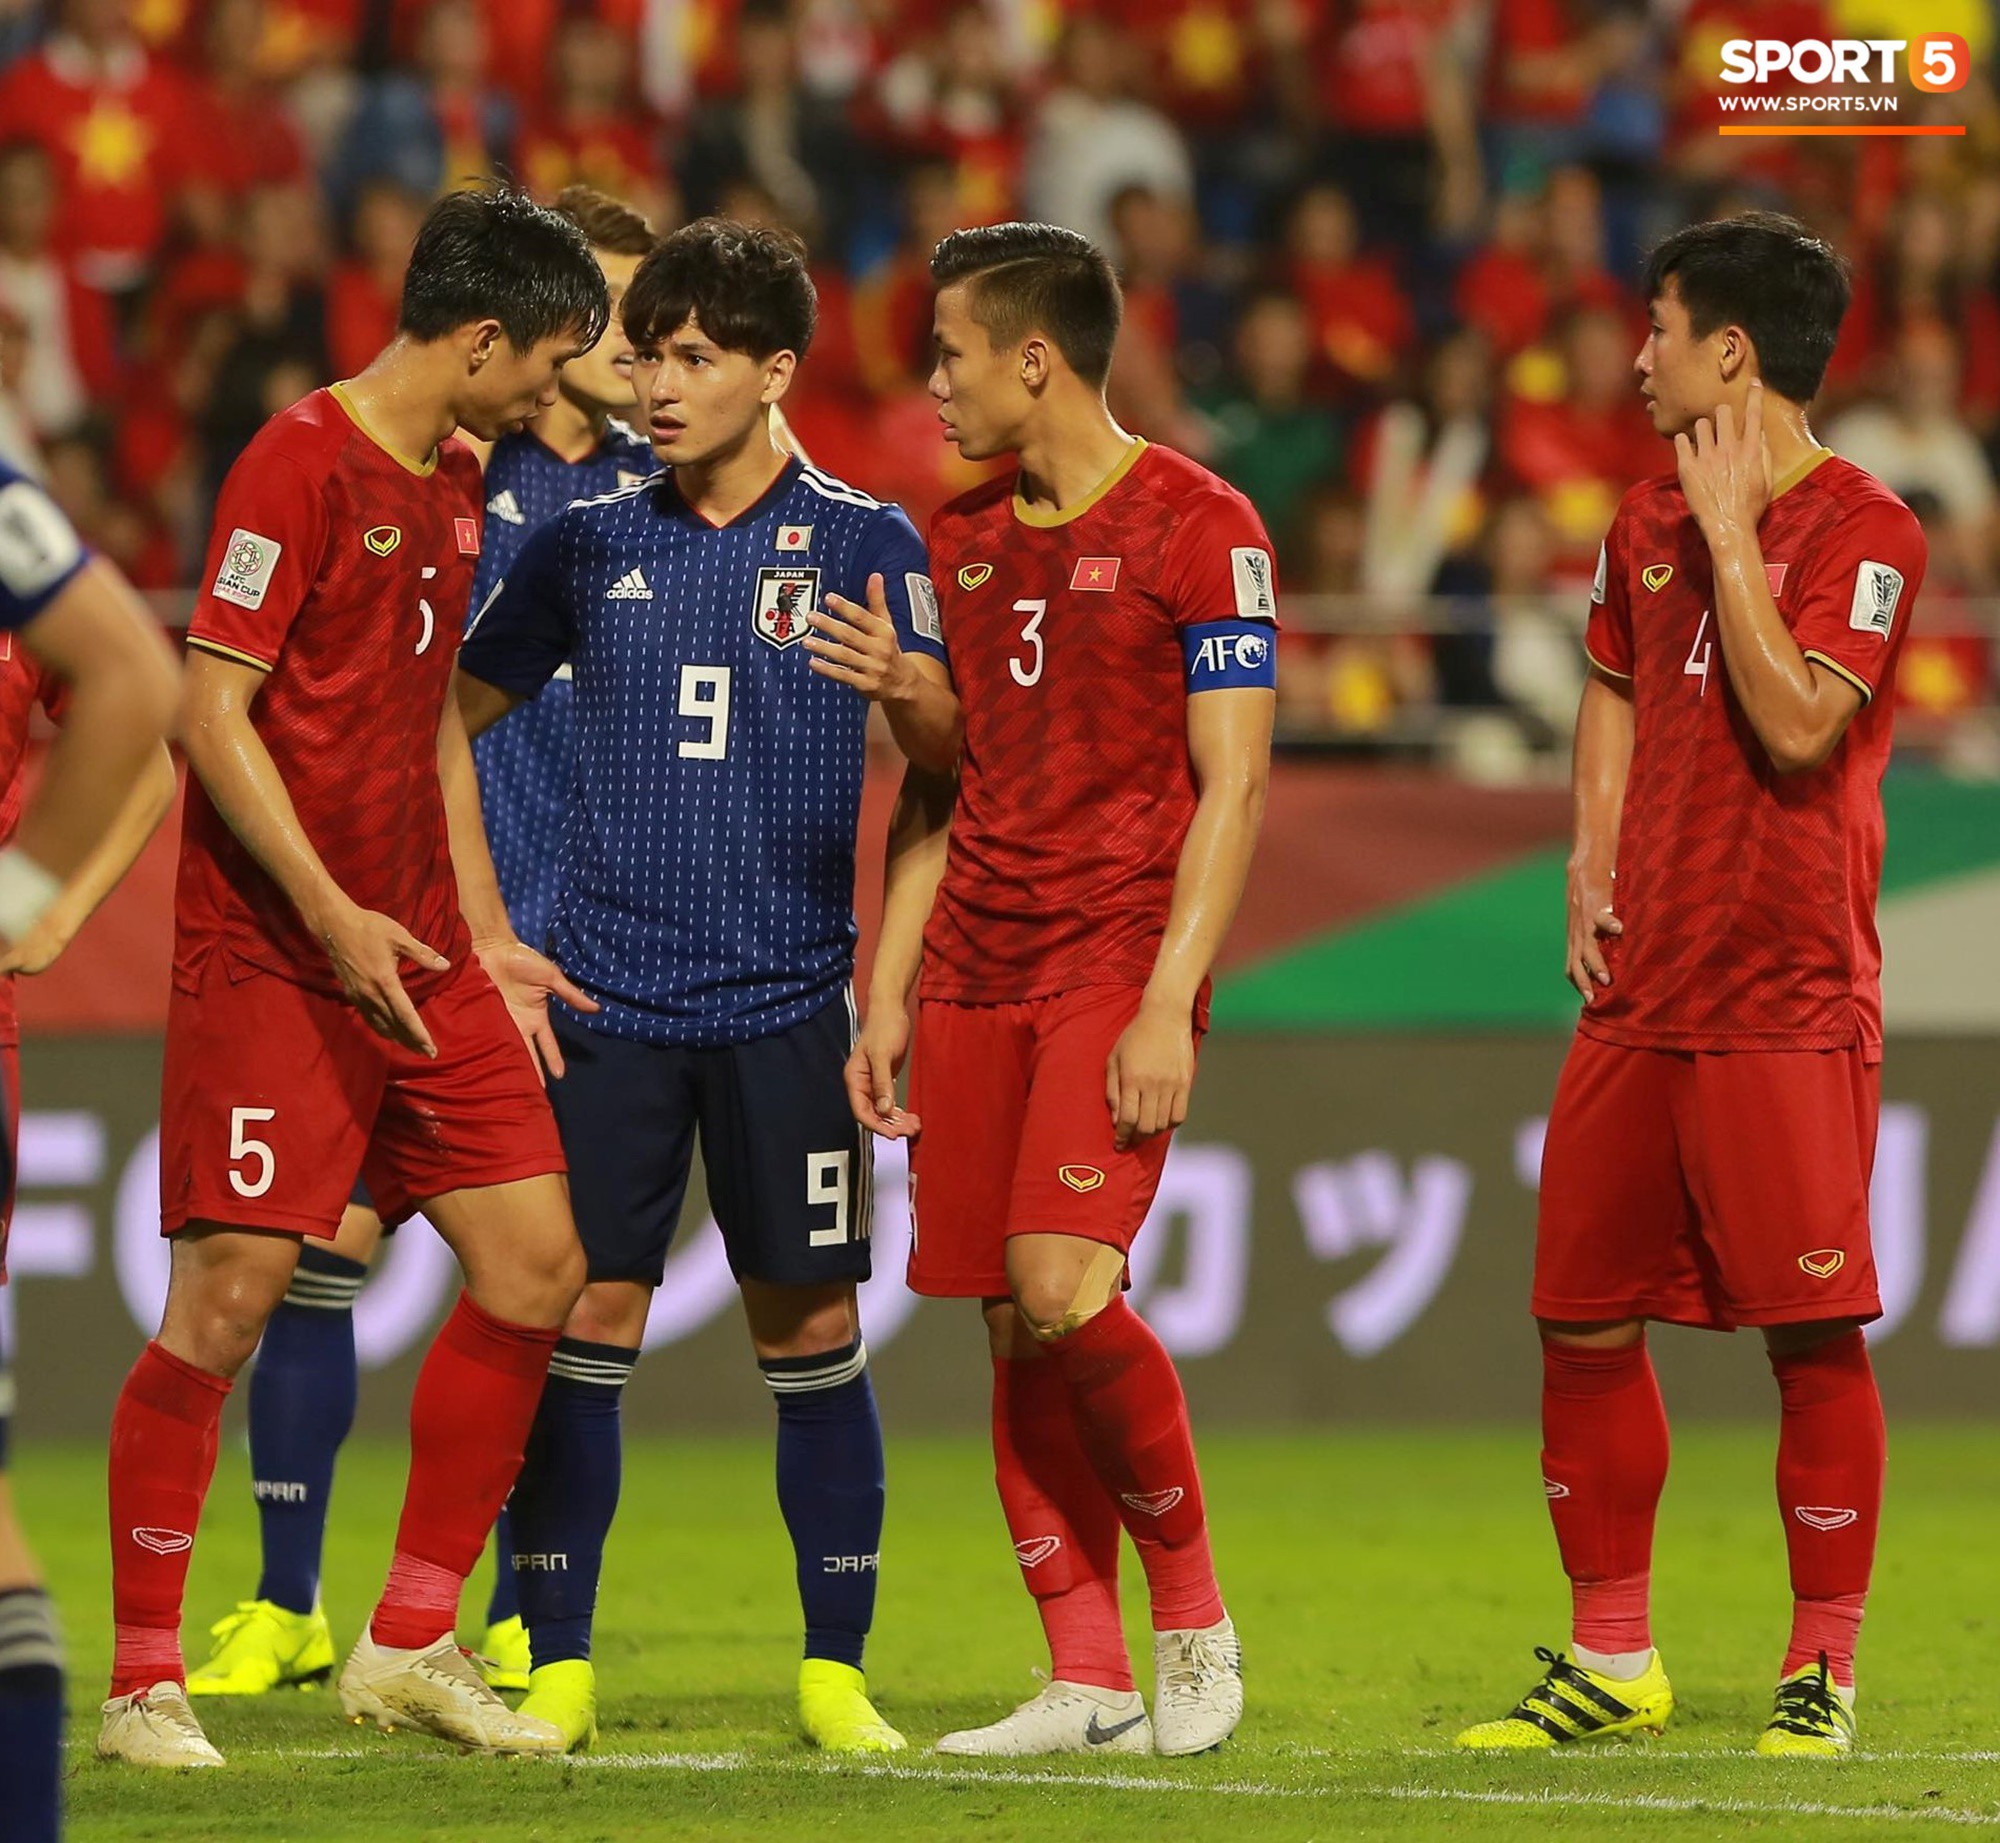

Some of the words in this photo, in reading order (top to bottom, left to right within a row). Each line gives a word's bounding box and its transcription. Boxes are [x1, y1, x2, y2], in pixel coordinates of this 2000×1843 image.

[229, 573, 246, 584] AFC
[240, 585, 261, 597] CUP
[606, 587, 654, 599] adidas
[769, 621, 796, 634] JFA
[1009, 599, 1046, 687] 3
[1190, 633, 1269, 676] AFC
[1684, 610, 1711, 697] 4
[678, 664, 731, 760] 9
[228, 1107, 276, 1198] 5
[807, 1150, 849, 1247] 9
[254, 1481, 307, 1502] PAN
[511, 1553, 568, 1571] PAN
